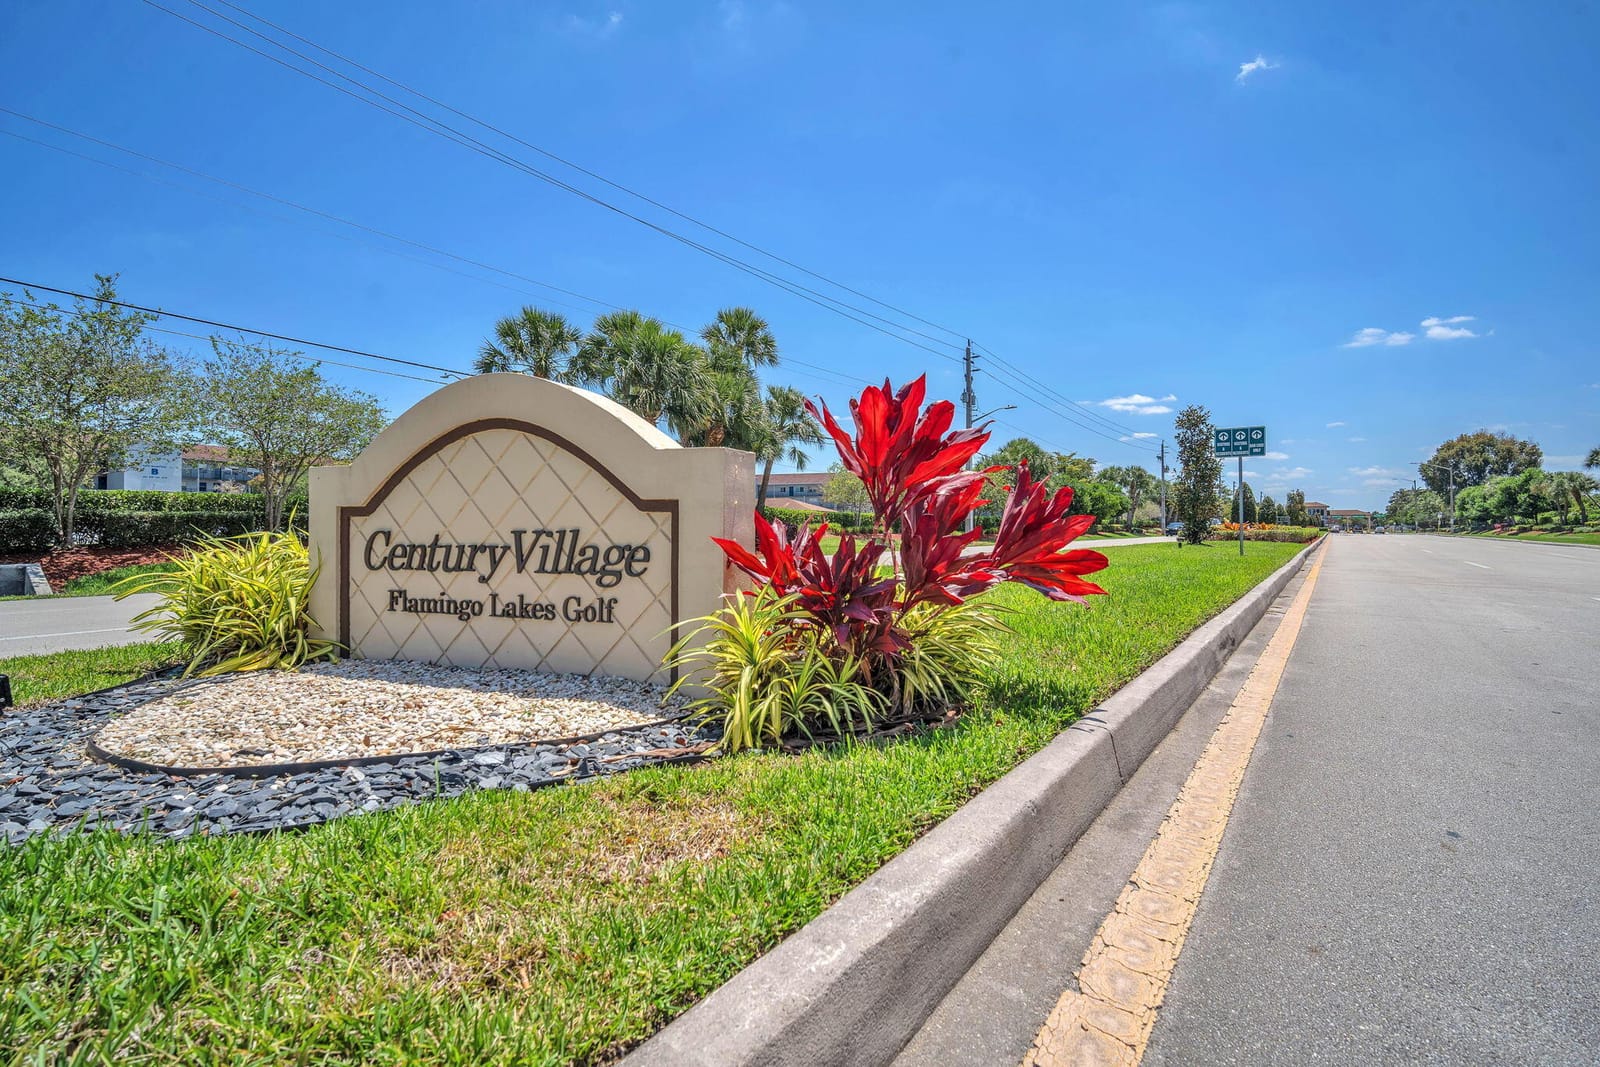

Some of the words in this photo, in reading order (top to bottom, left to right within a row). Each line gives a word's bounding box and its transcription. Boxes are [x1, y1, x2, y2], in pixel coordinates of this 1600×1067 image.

[364, 529, 511, 584] Century
[510, 529, 651, 588] Village
[387, 589, 484, 622] Flamingo
[489, 593, 556, 621] Lakes
[562, 596, 618, 623] Golf
